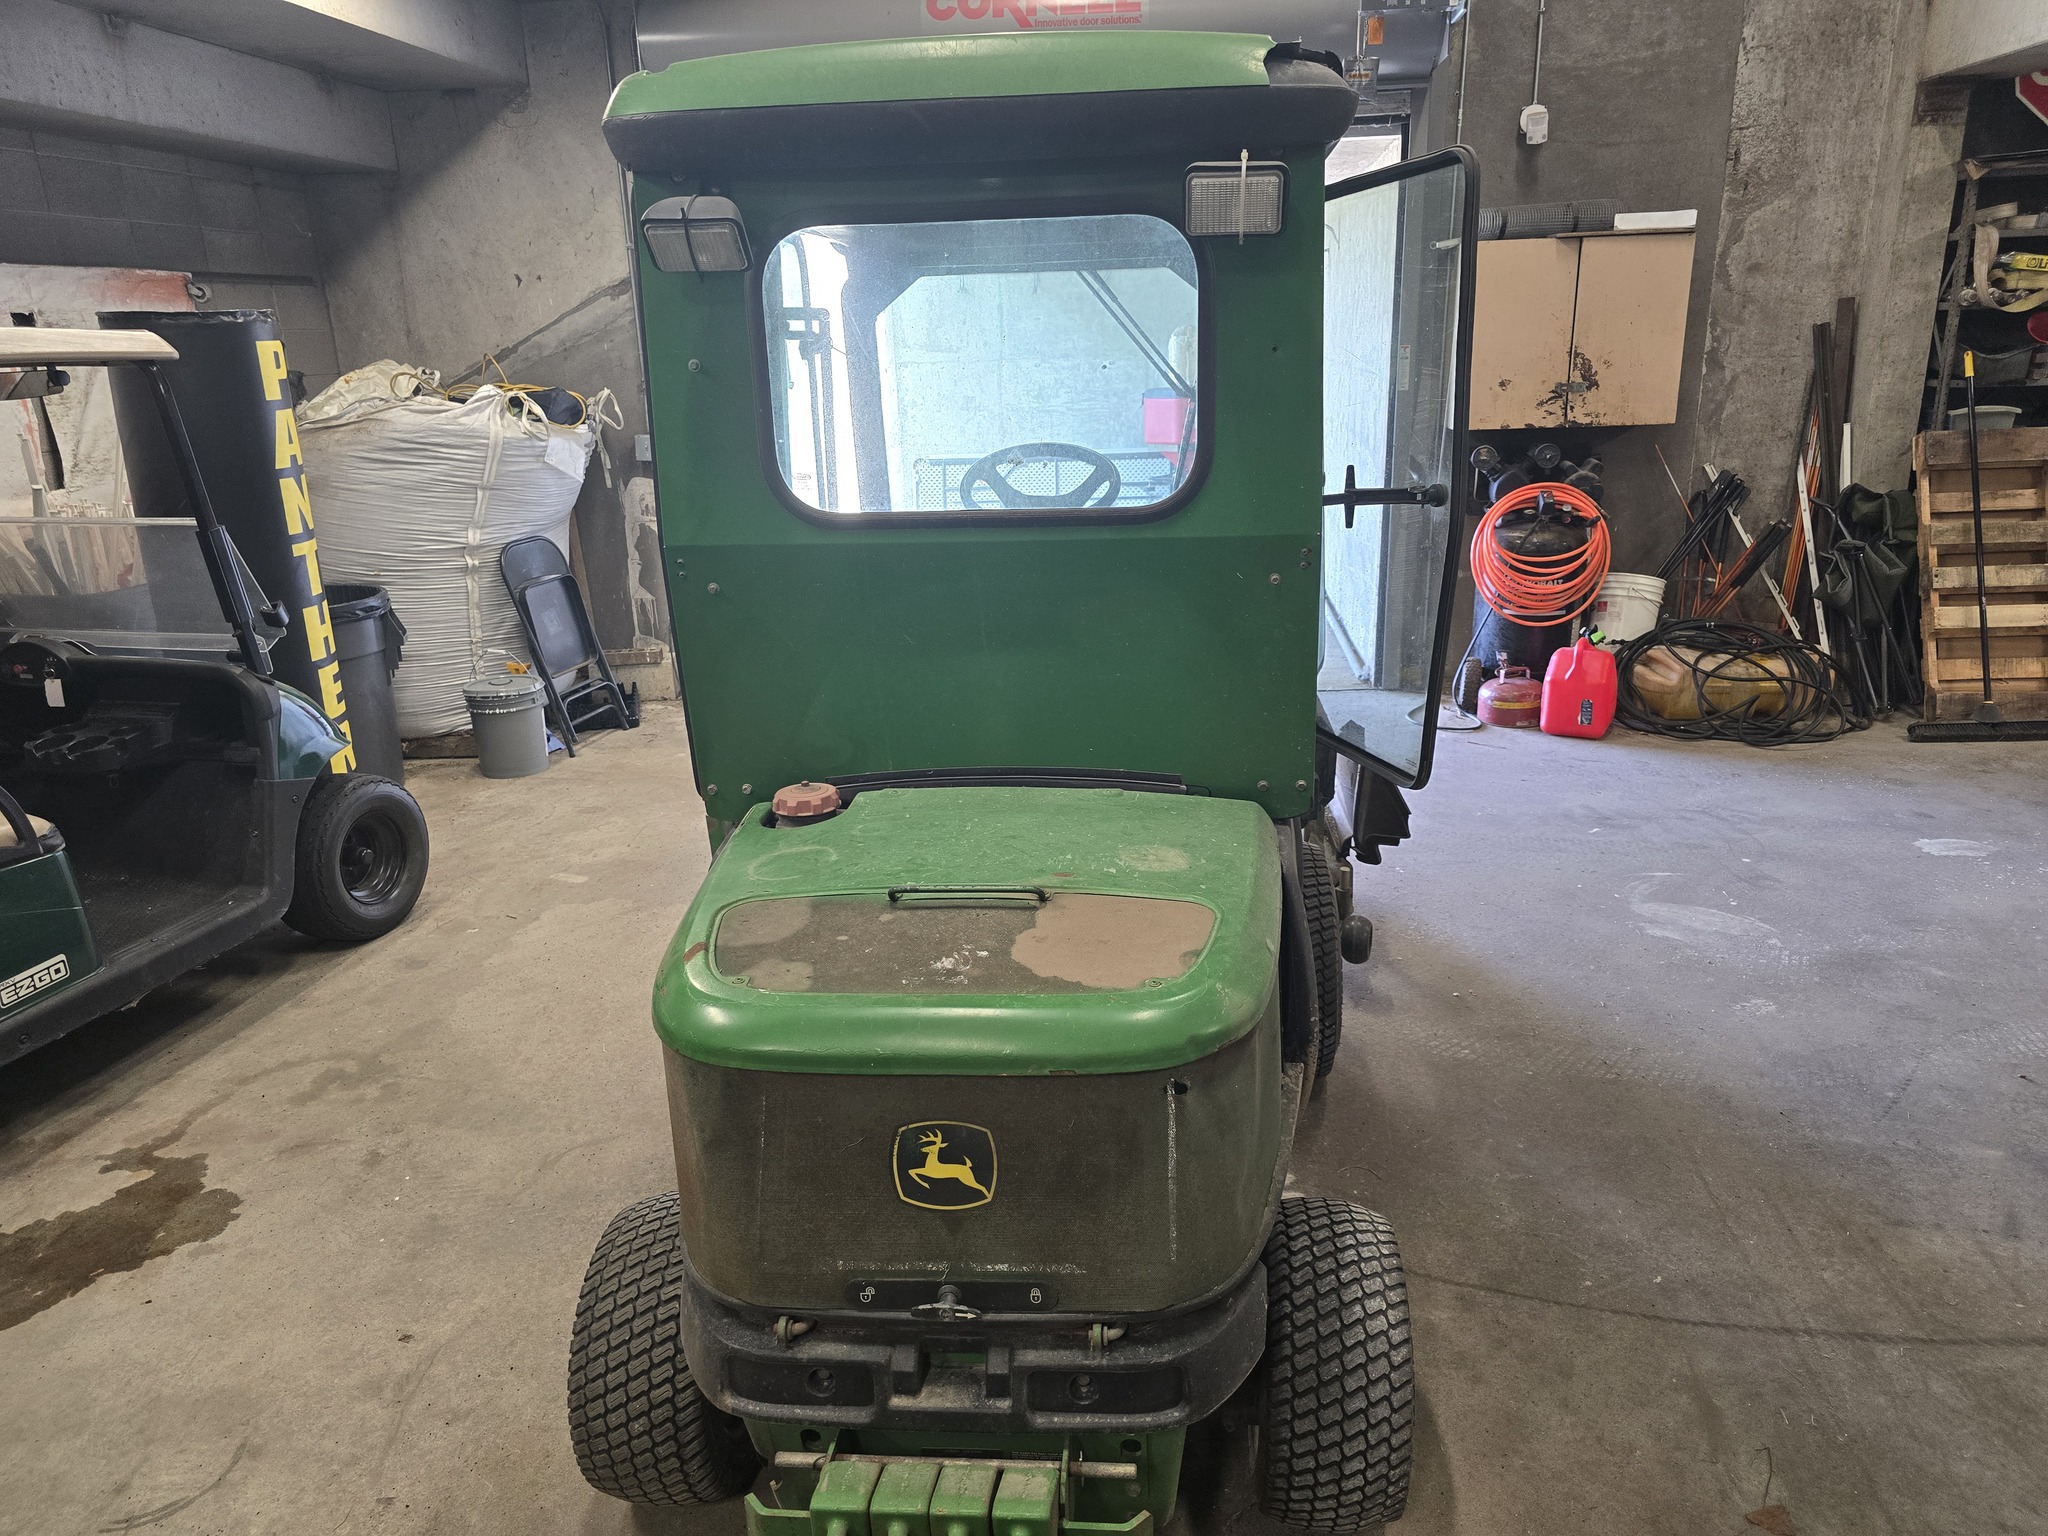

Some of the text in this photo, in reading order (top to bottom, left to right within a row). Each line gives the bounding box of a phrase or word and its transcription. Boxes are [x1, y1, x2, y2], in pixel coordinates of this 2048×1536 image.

[1034, 17, 1078, 28] Innovative
[1080, 16, 1100, 26] door
[255, 340, 357, 774] PANTHER
